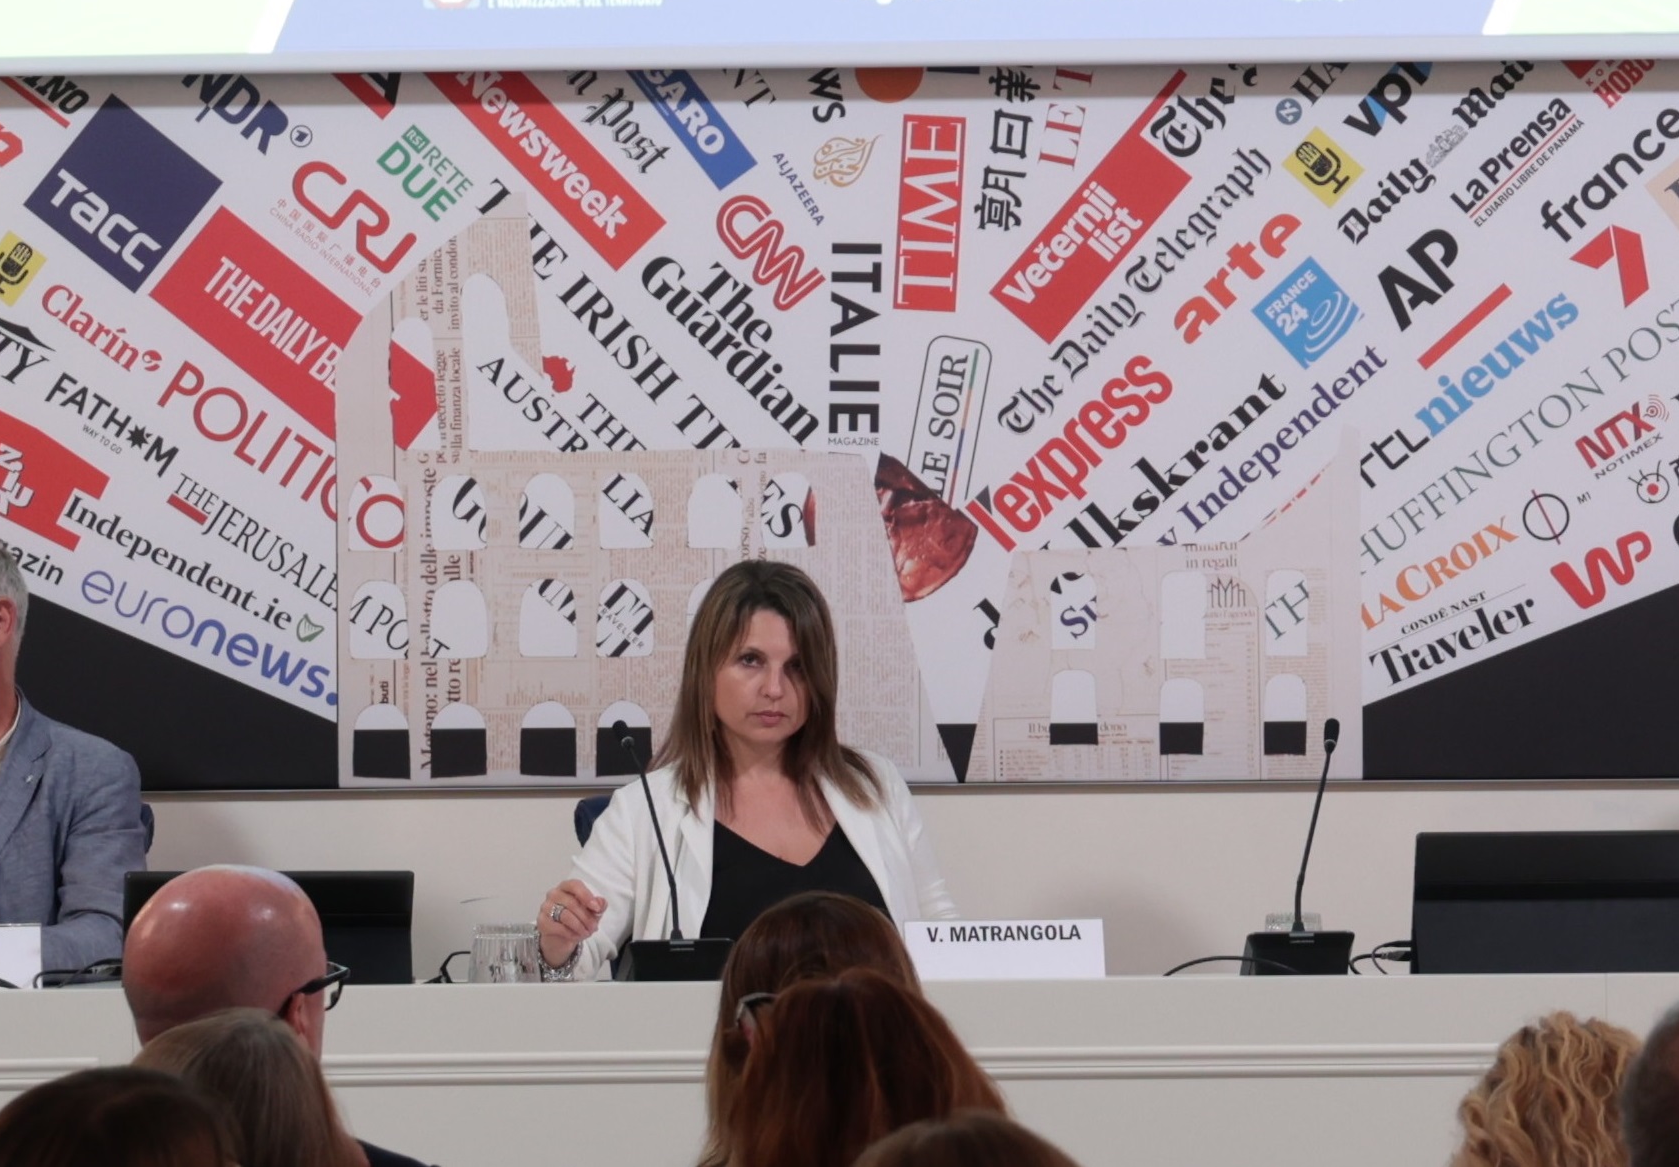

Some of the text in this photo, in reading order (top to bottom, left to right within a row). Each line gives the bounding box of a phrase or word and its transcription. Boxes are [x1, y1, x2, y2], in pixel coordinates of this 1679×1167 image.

[376, 140, 457, 223] DUE
[454, 72, 630, 241] Newsweek
[896, 120, 962, 306] TIME
[1124, 143, 1273, 294] Telegraph
[695, 261, 774, 346] The
[716, 193, 826, 312] CNN
[1172, 212, 1303, 345] arte
[1377, 227, 1460, 333] AP
[556, 270, 683, 405] IRISH
[639, 255, 821, 447] Guardian
[827, 241, 883, 435] ITALIE
[1414, 290, 1581, 437] nieuws
[1175, 343, 1390, 537] Independent
[63, 493, 294, 631] Independent.ie
[1369, 596, 1538, 688] Traveler
[925, 923, 1082, 943] V. MATRANGOLA
